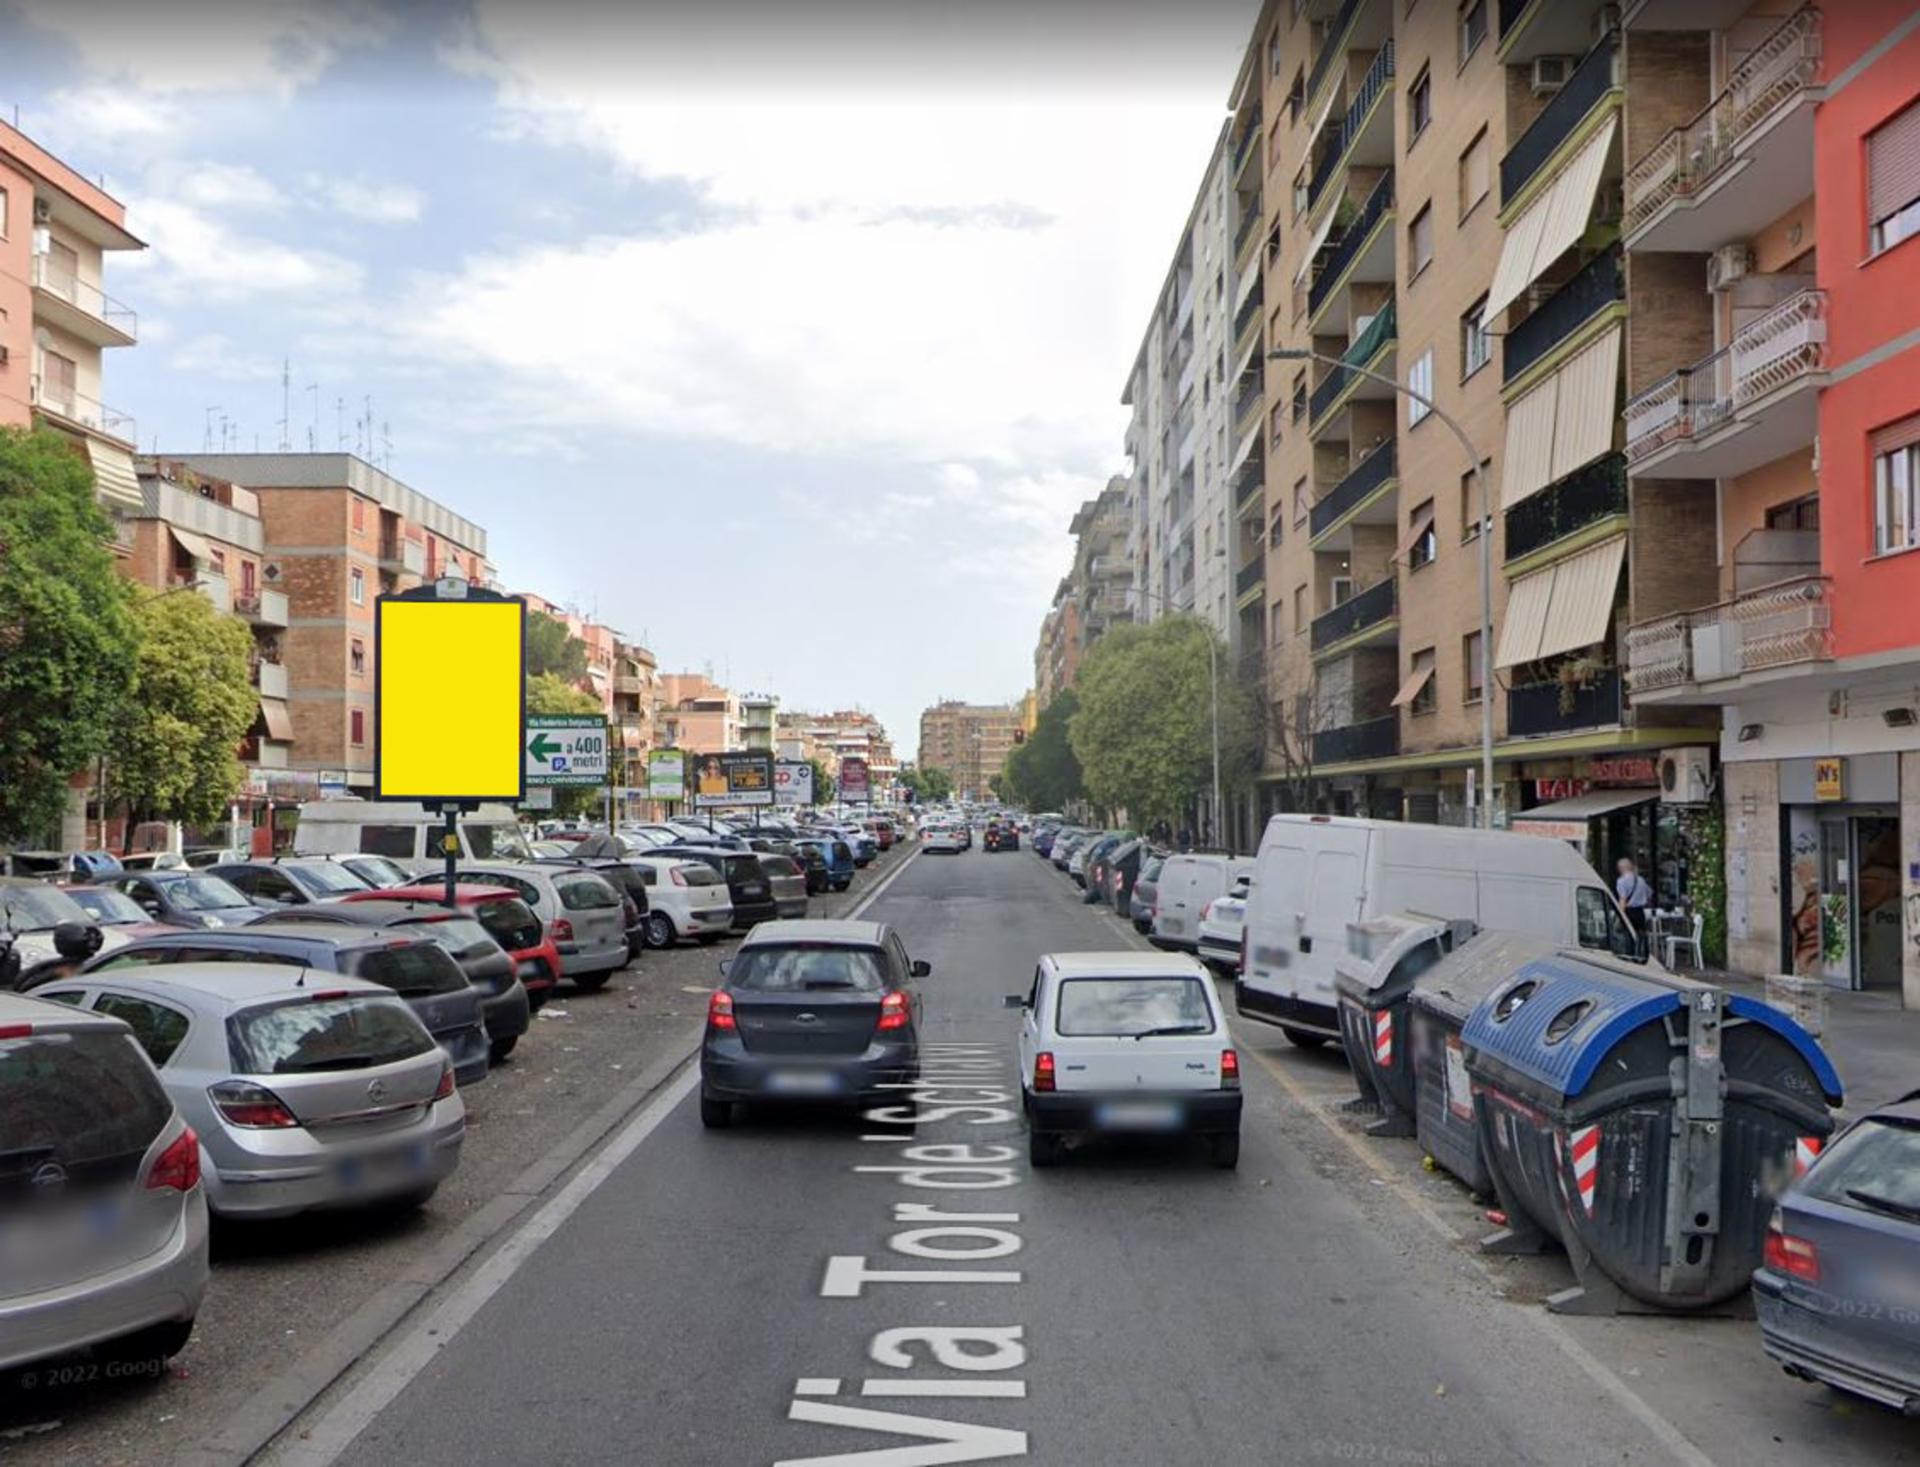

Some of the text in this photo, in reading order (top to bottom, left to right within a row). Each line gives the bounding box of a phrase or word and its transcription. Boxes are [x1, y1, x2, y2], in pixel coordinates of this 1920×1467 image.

[575, 737, 602, 754] 400
[573, 755, 602, 768] metri
[1536, 778, 1590, 800] BAR
